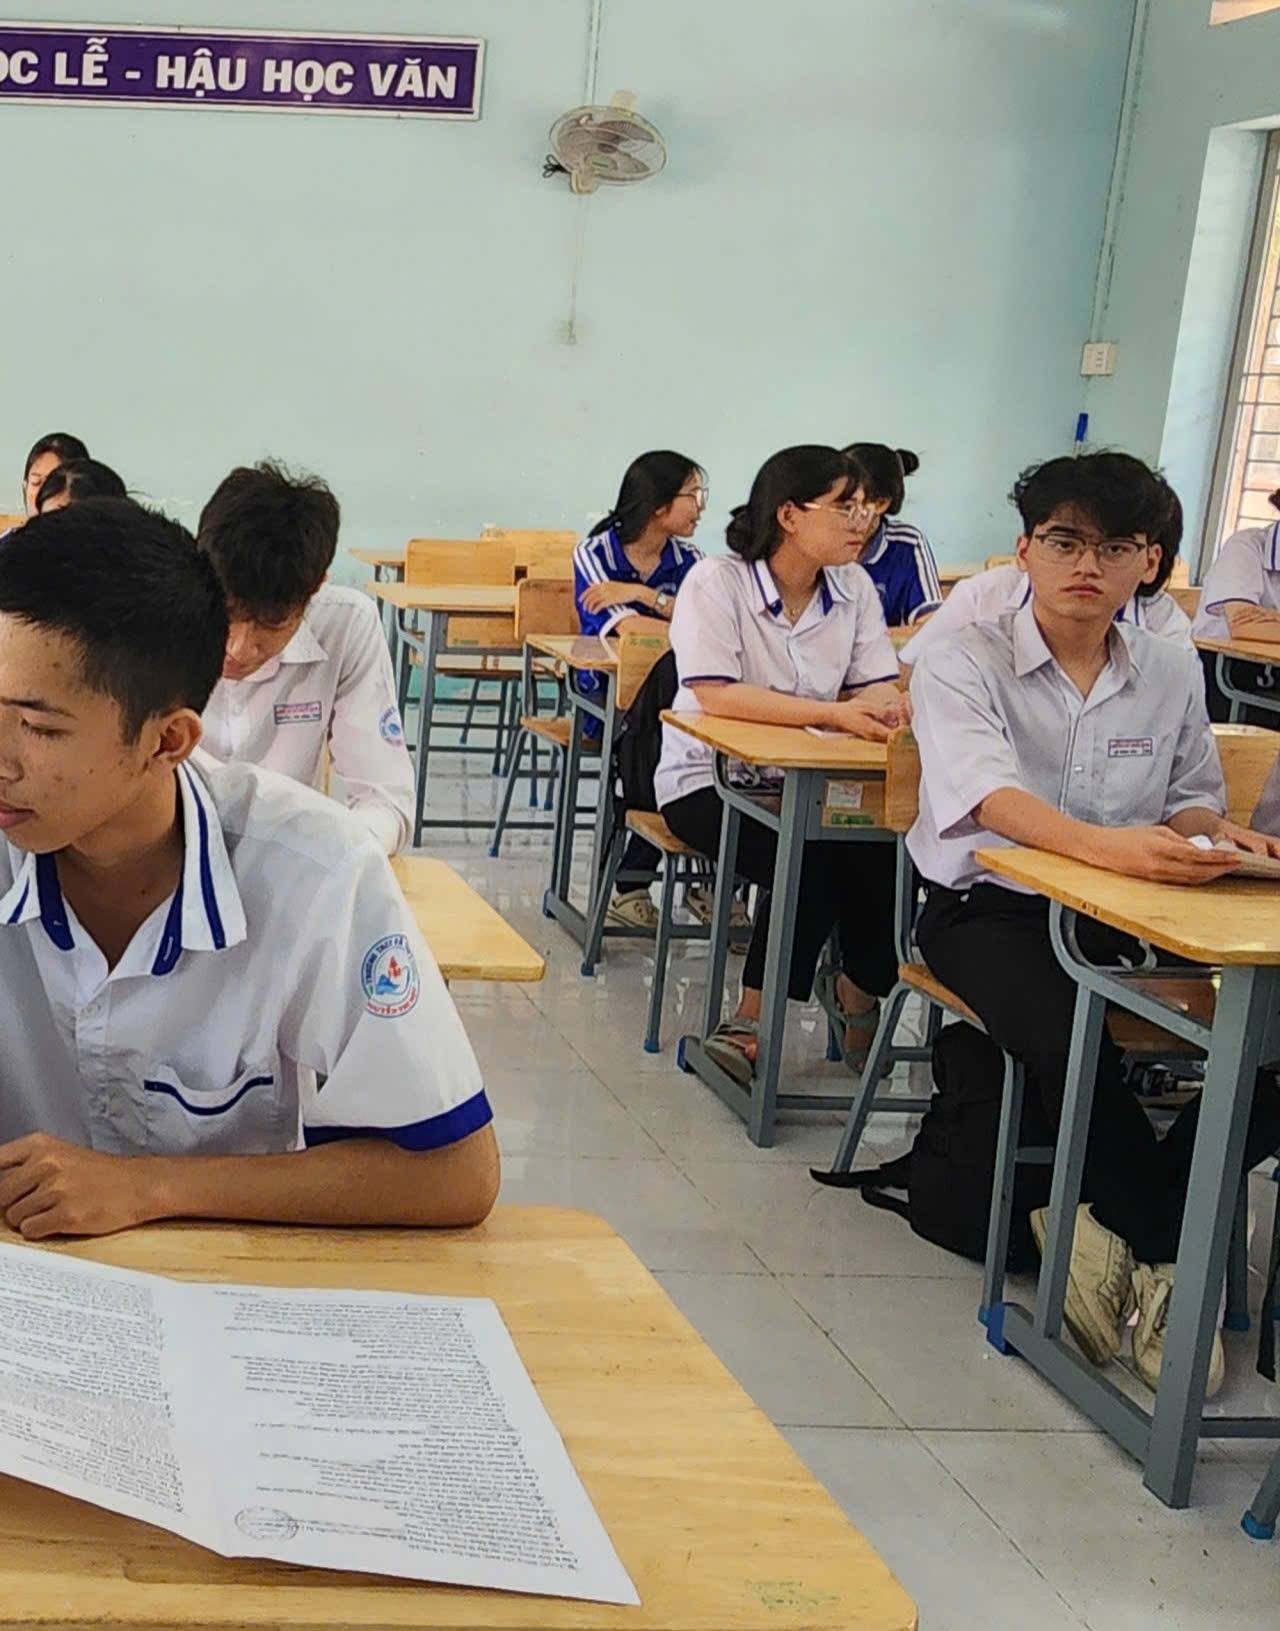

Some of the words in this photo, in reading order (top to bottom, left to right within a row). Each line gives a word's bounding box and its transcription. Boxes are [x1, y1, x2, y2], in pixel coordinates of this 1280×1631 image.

[54, 37, 109, 86] LỄ
[125, 71, 141, 79] -
[156, 47, 247, 97] HẬU
[262, 59, 354, 101] HỌC
[368, 58, 457, 98] VĂN
